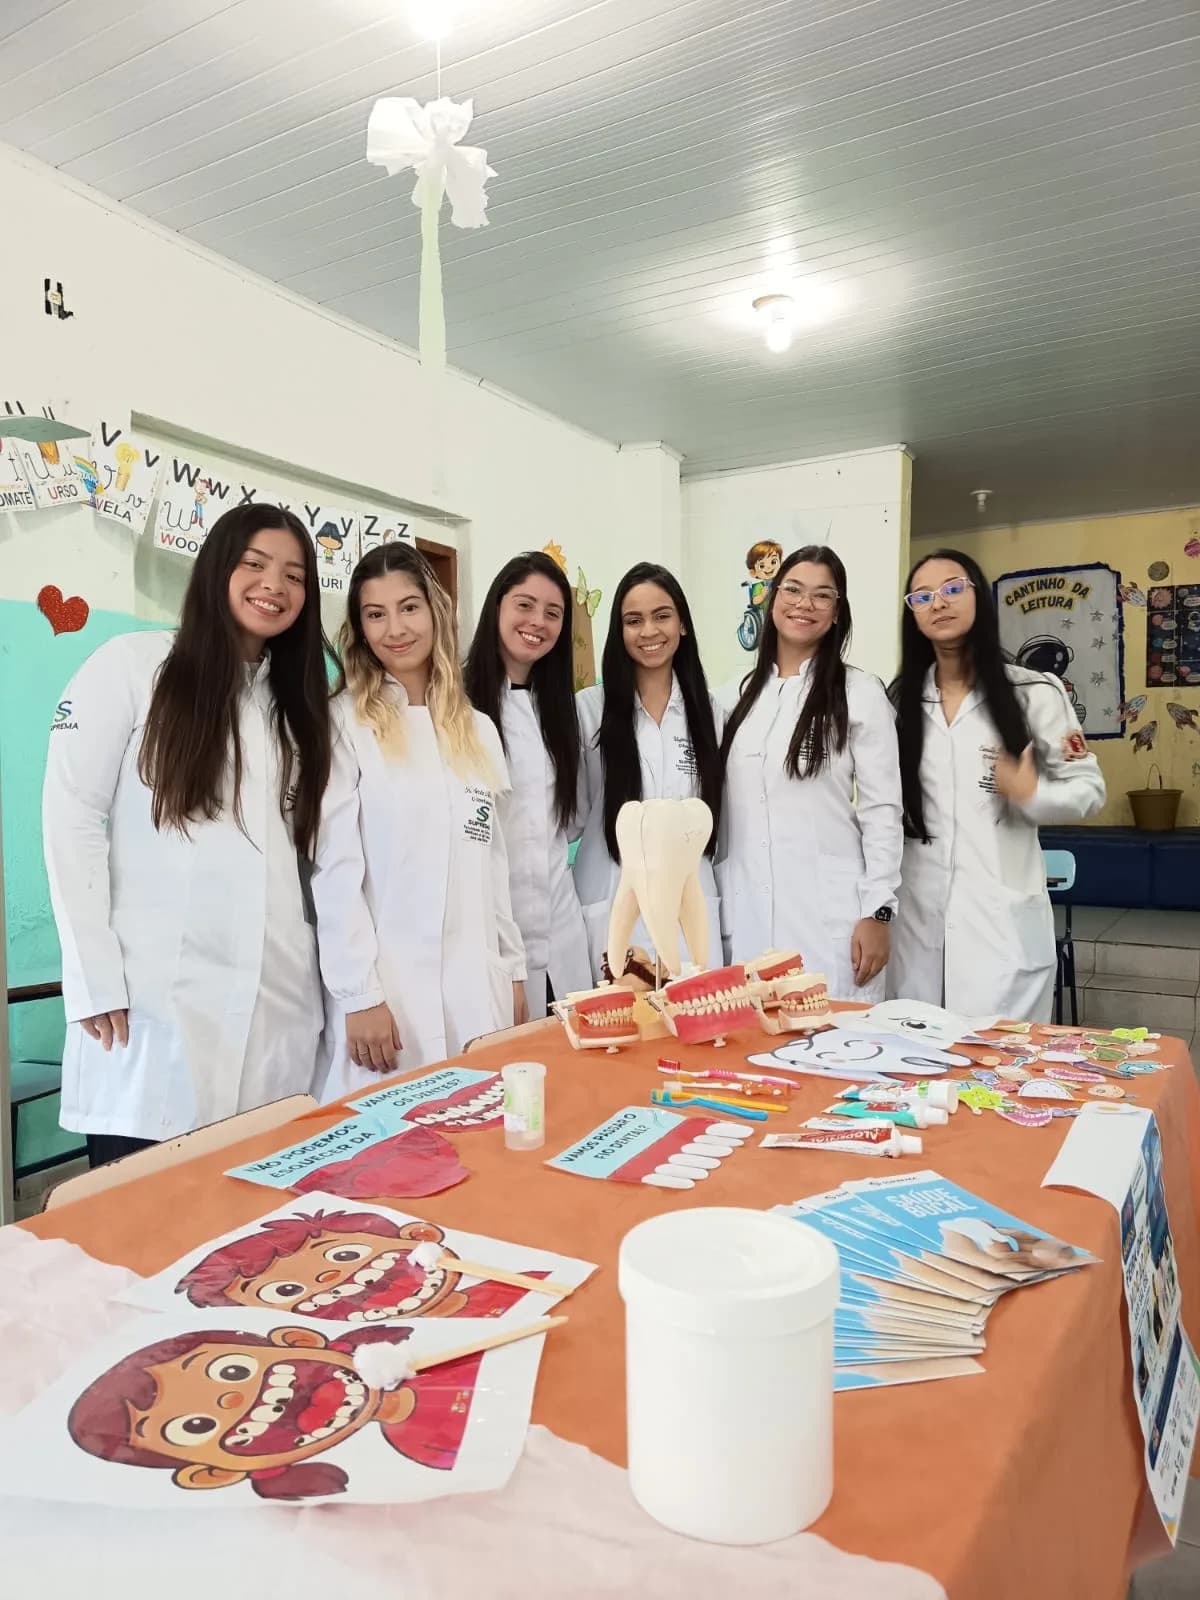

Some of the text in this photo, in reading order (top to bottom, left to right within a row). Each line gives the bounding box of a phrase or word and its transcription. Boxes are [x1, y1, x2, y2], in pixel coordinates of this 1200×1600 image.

[101, 422, 122, 447] V
[173, 459, 201, 488] W
[0, 491, 33, 507] OMATE
[47, 484, 78, 500] URSO
[95, 498, 132, 523] VELA
[304, 504, 321, 527] Y
[363, 515, 381, 536] Z
[160, 532, 202, 552] WOO
[320, 577, 343, 590] URI
[1005, 577, 1090, 606] CANTINHO DA
[1020, 596, 1074, 615] LEITURA
[393, 1097, 413, 1107] OS
[281, 1124, 358, 1160] PODEMOS
[560, 1140, 599, 1163] VAMOS
[623, 1112, 637, 1120] O
[270, 1132, 375, 1178] ESQUECER DA
[594, 1148, 615, 1160] FIO
